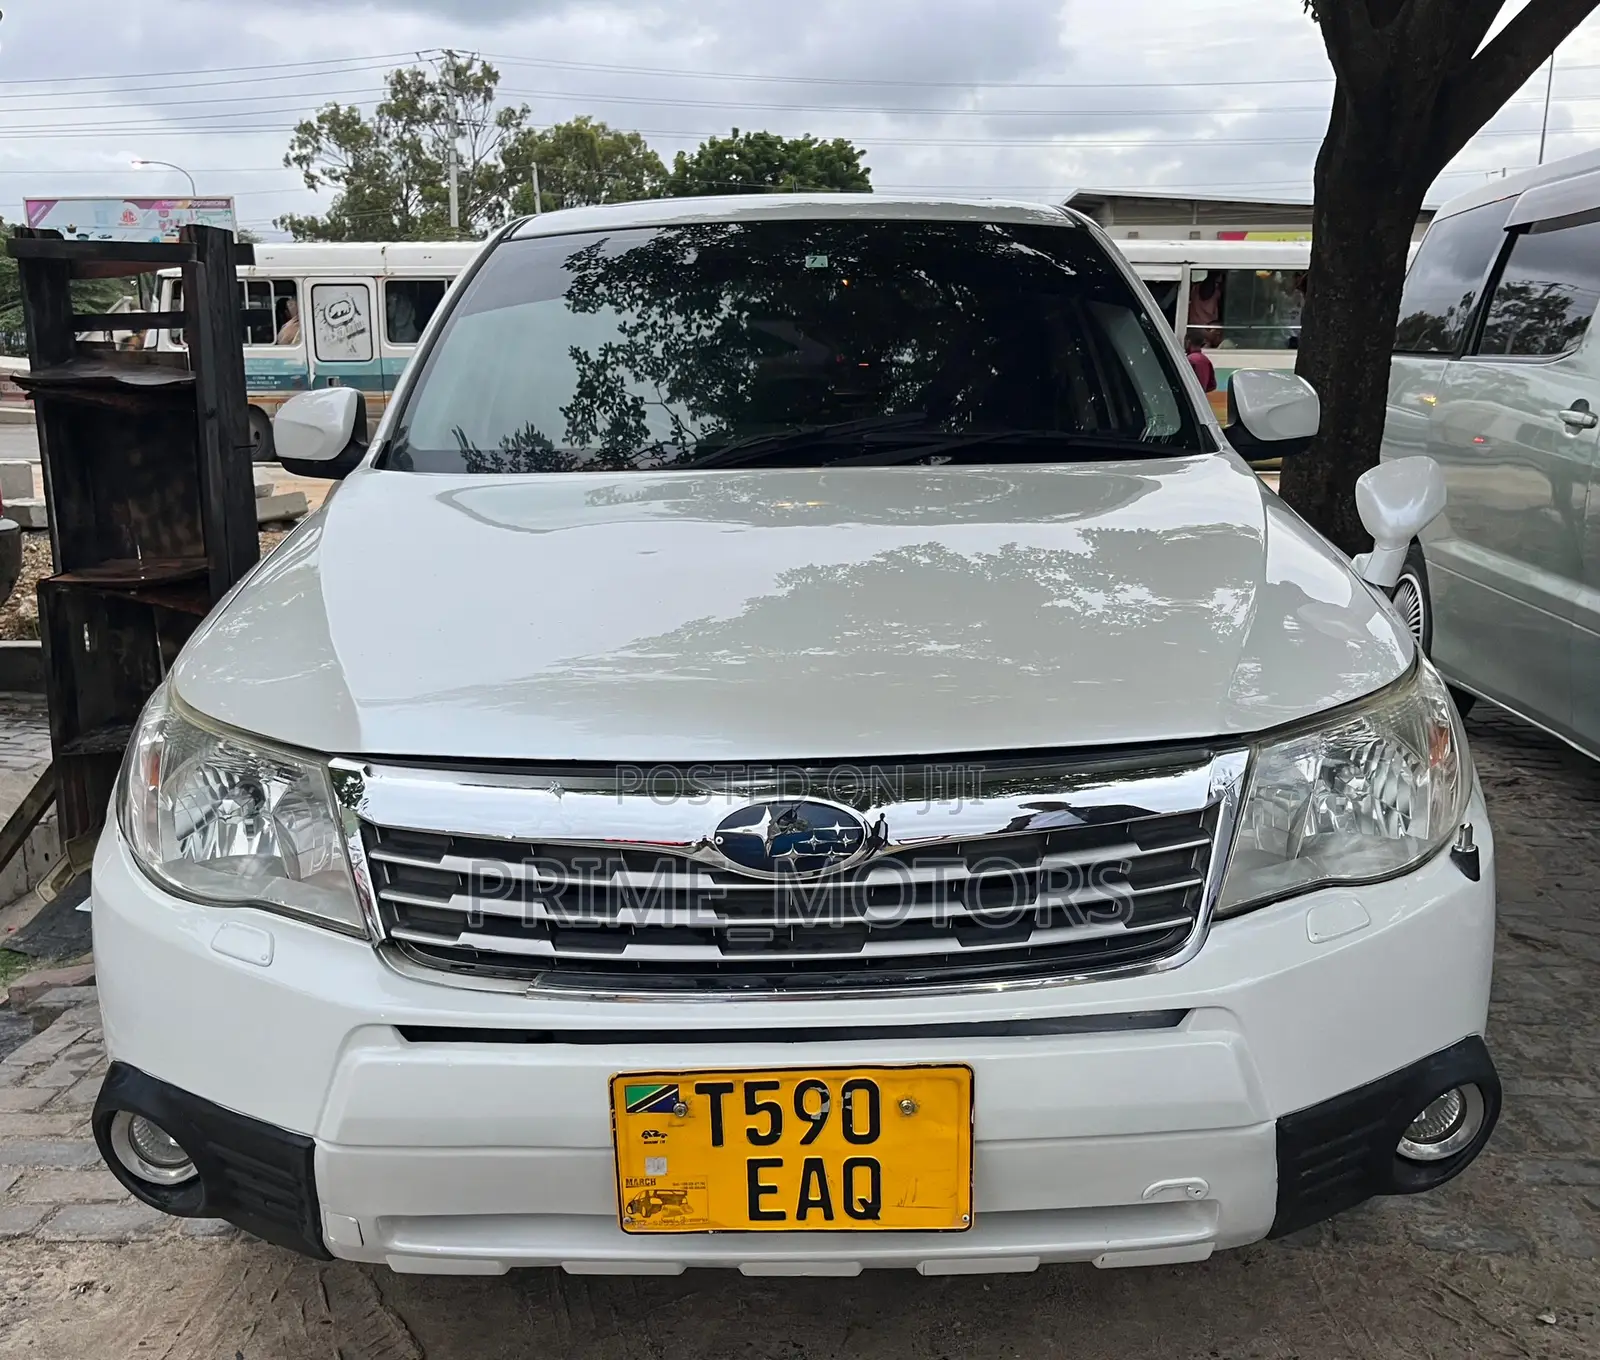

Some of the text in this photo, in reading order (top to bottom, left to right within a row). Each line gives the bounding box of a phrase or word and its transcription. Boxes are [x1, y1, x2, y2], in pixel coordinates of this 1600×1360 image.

[694, 1077, 881, 1147] T590
[625, 1177, 657, 1187] MARCH
[746, 1156, 882, 1221] EAQ
